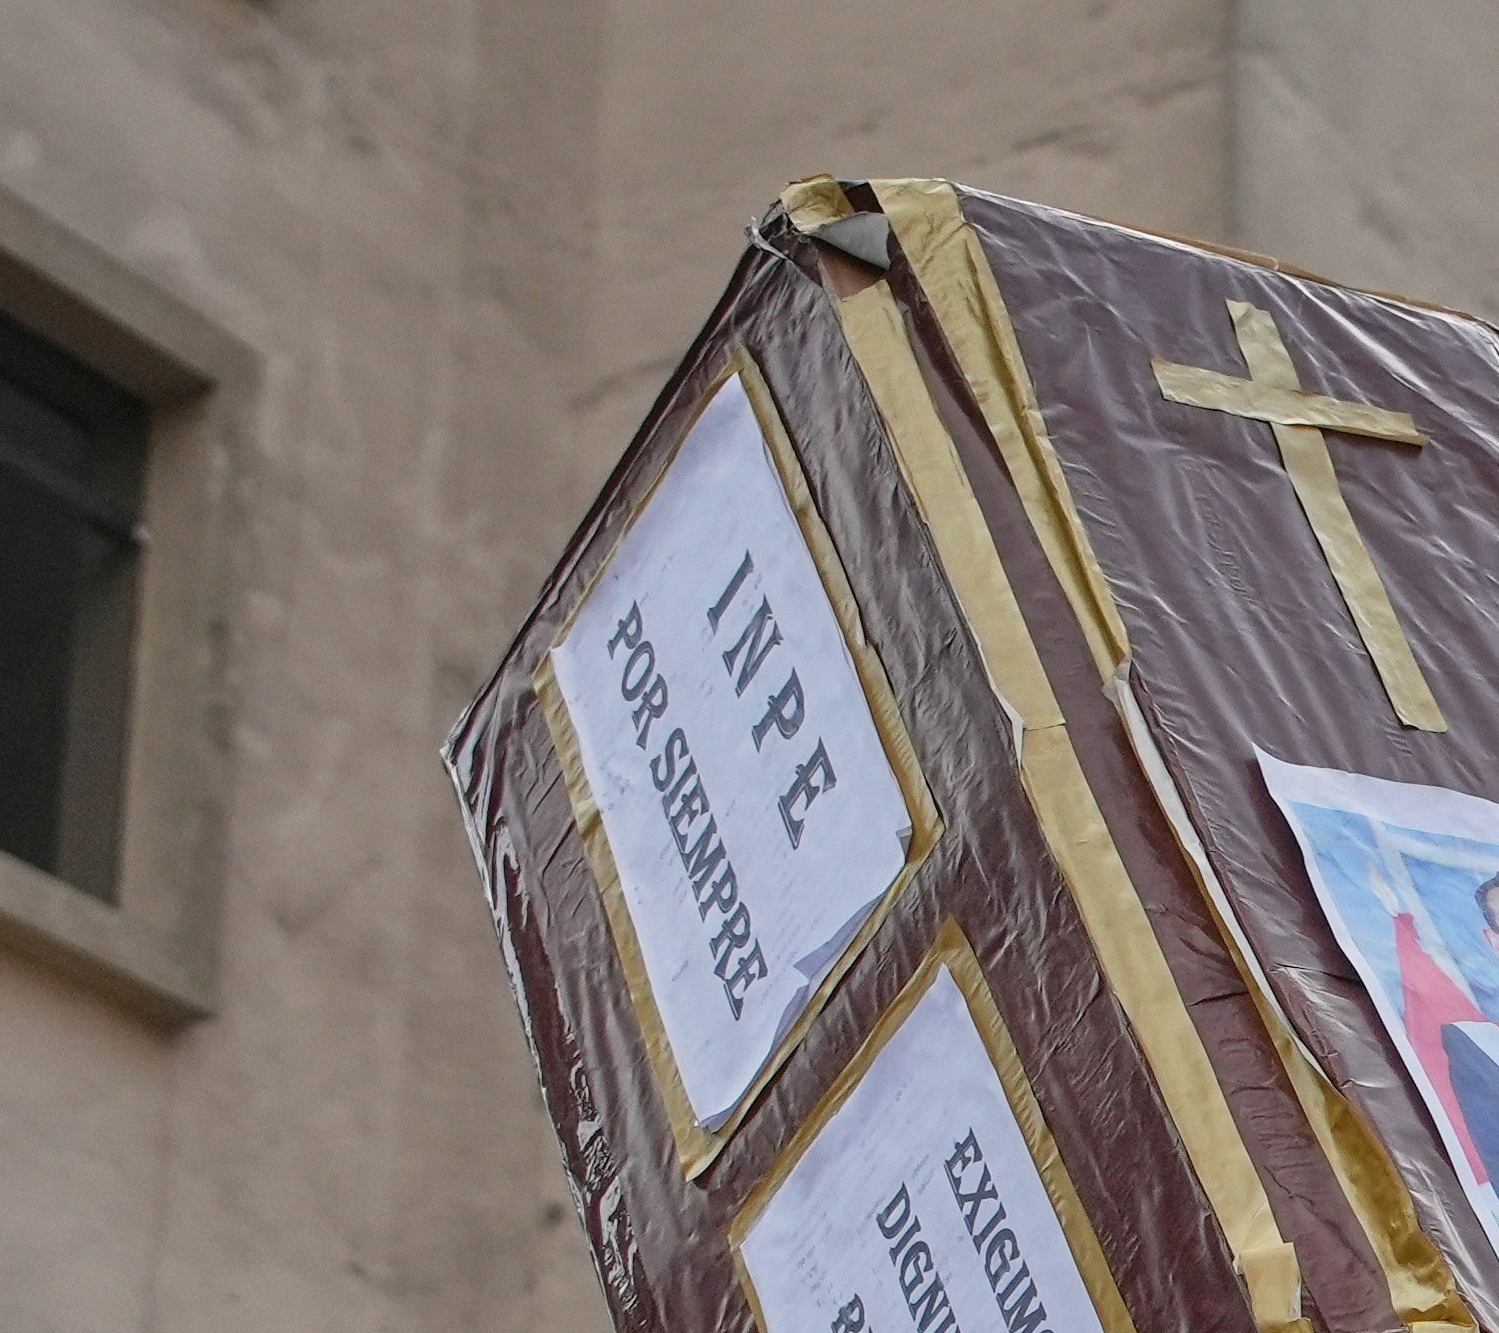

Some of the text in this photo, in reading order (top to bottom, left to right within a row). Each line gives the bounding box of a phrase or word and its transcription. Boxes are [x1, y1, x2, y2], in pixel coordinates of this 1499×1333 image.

[607, 599, 769, 1022] POR SIEMPRE
[706, 549, 837, 851] INPE
